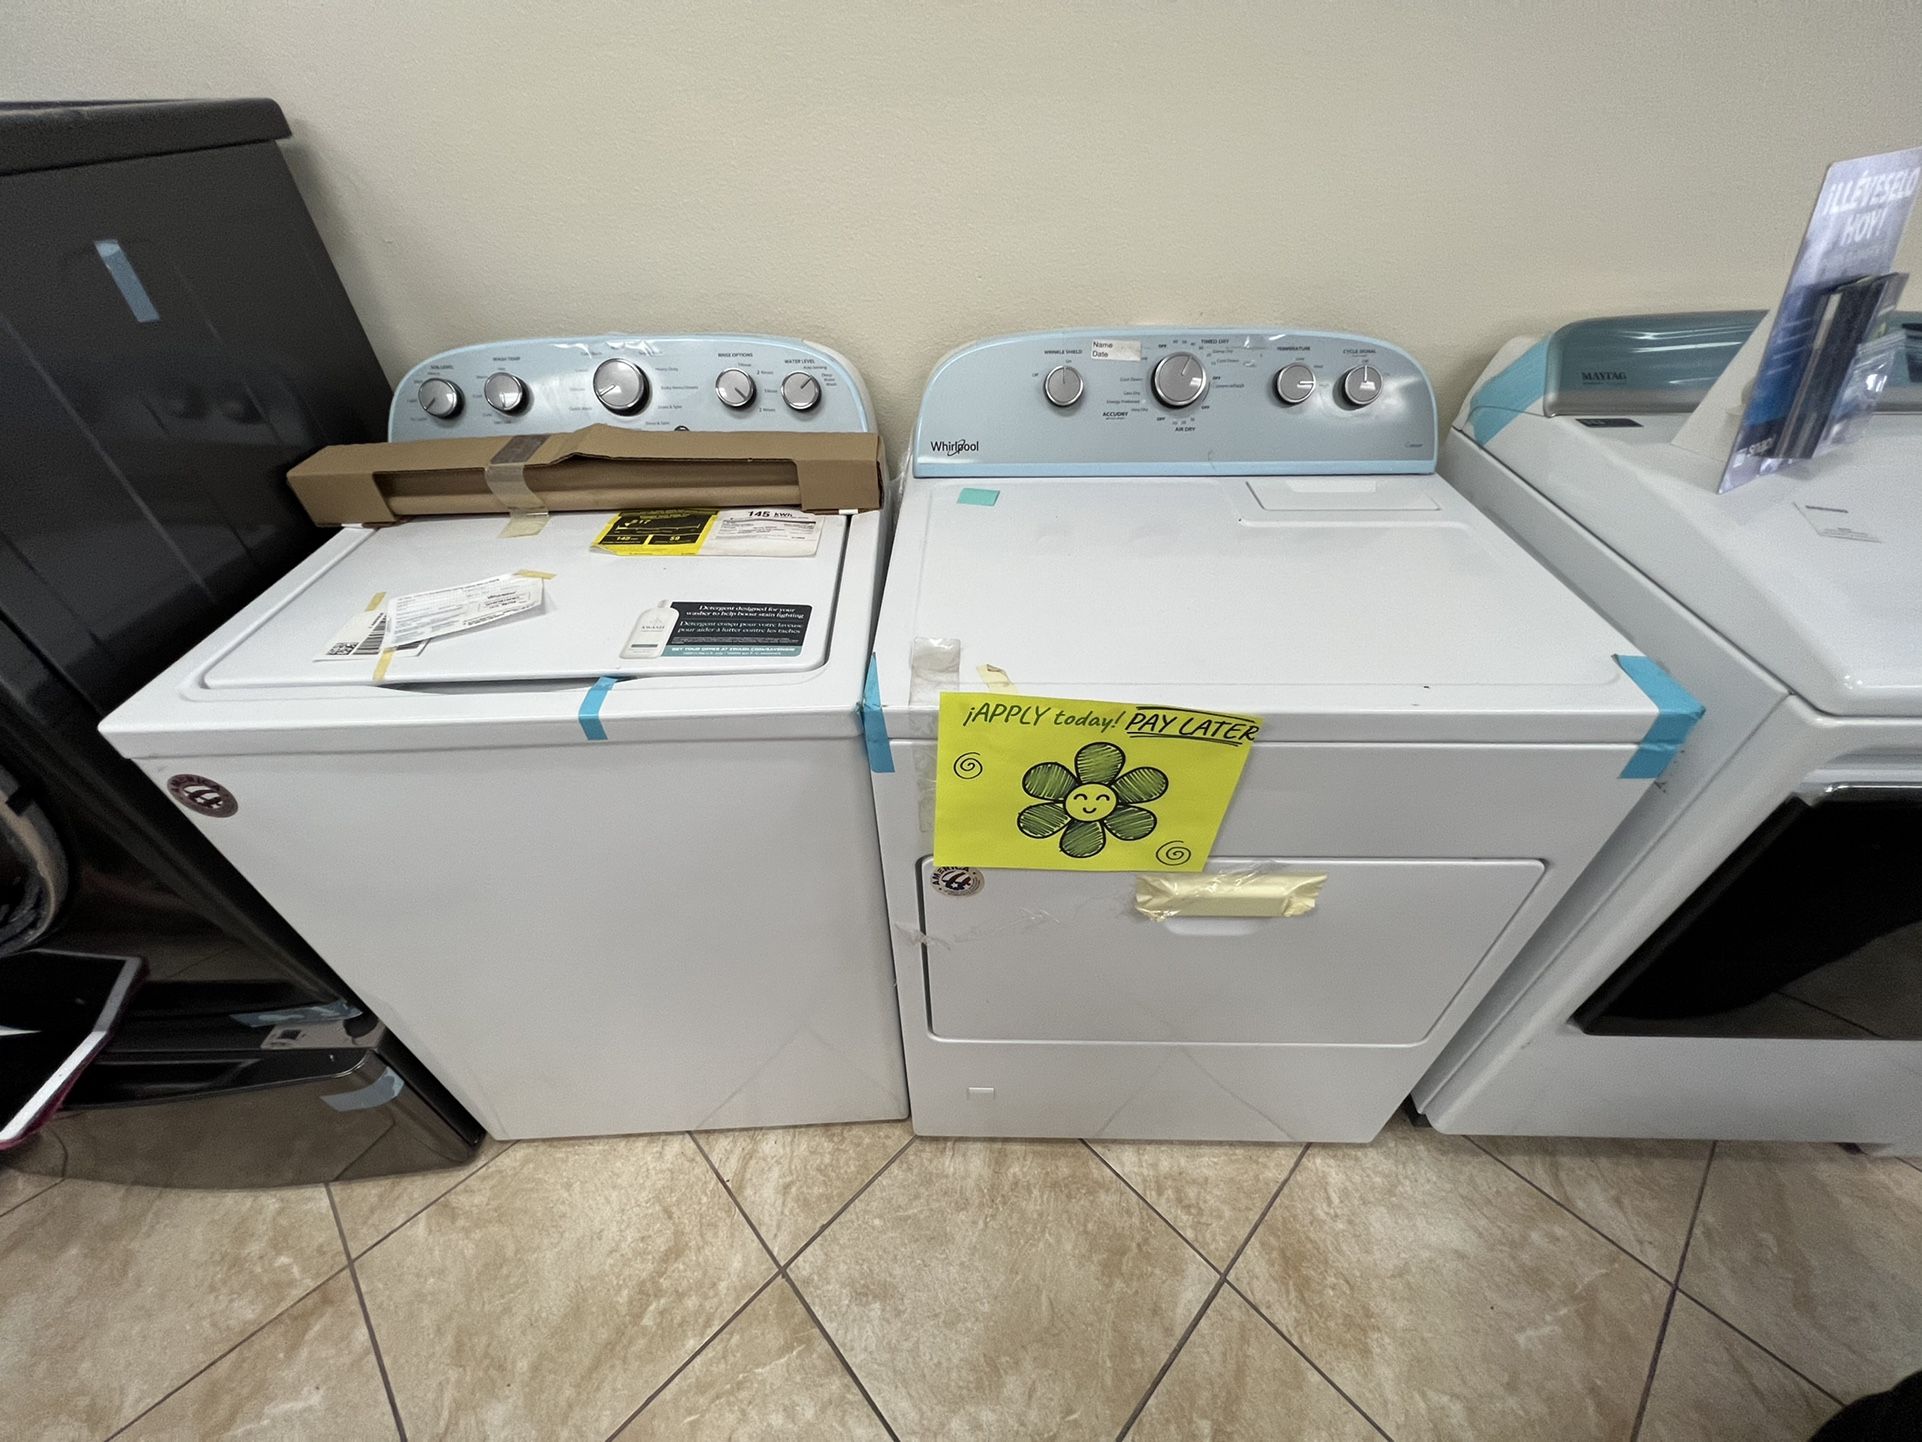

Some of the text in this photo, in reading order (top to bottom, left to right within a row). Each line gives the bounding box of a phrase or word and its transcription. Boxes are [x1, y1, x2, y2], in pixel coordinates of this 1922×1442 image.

[1093, 341, 1113, 349] Name
[1092, 350, 1109, 358] Date
[1581, 371, 1627, 381] MAYTAG
[930, 438, 980, 457] Whirlpool
[1053, 711, 1127, 734] today!
[1124, 712, 1178, 734] PAY
[1178, 716, 1260, 742] LATER
